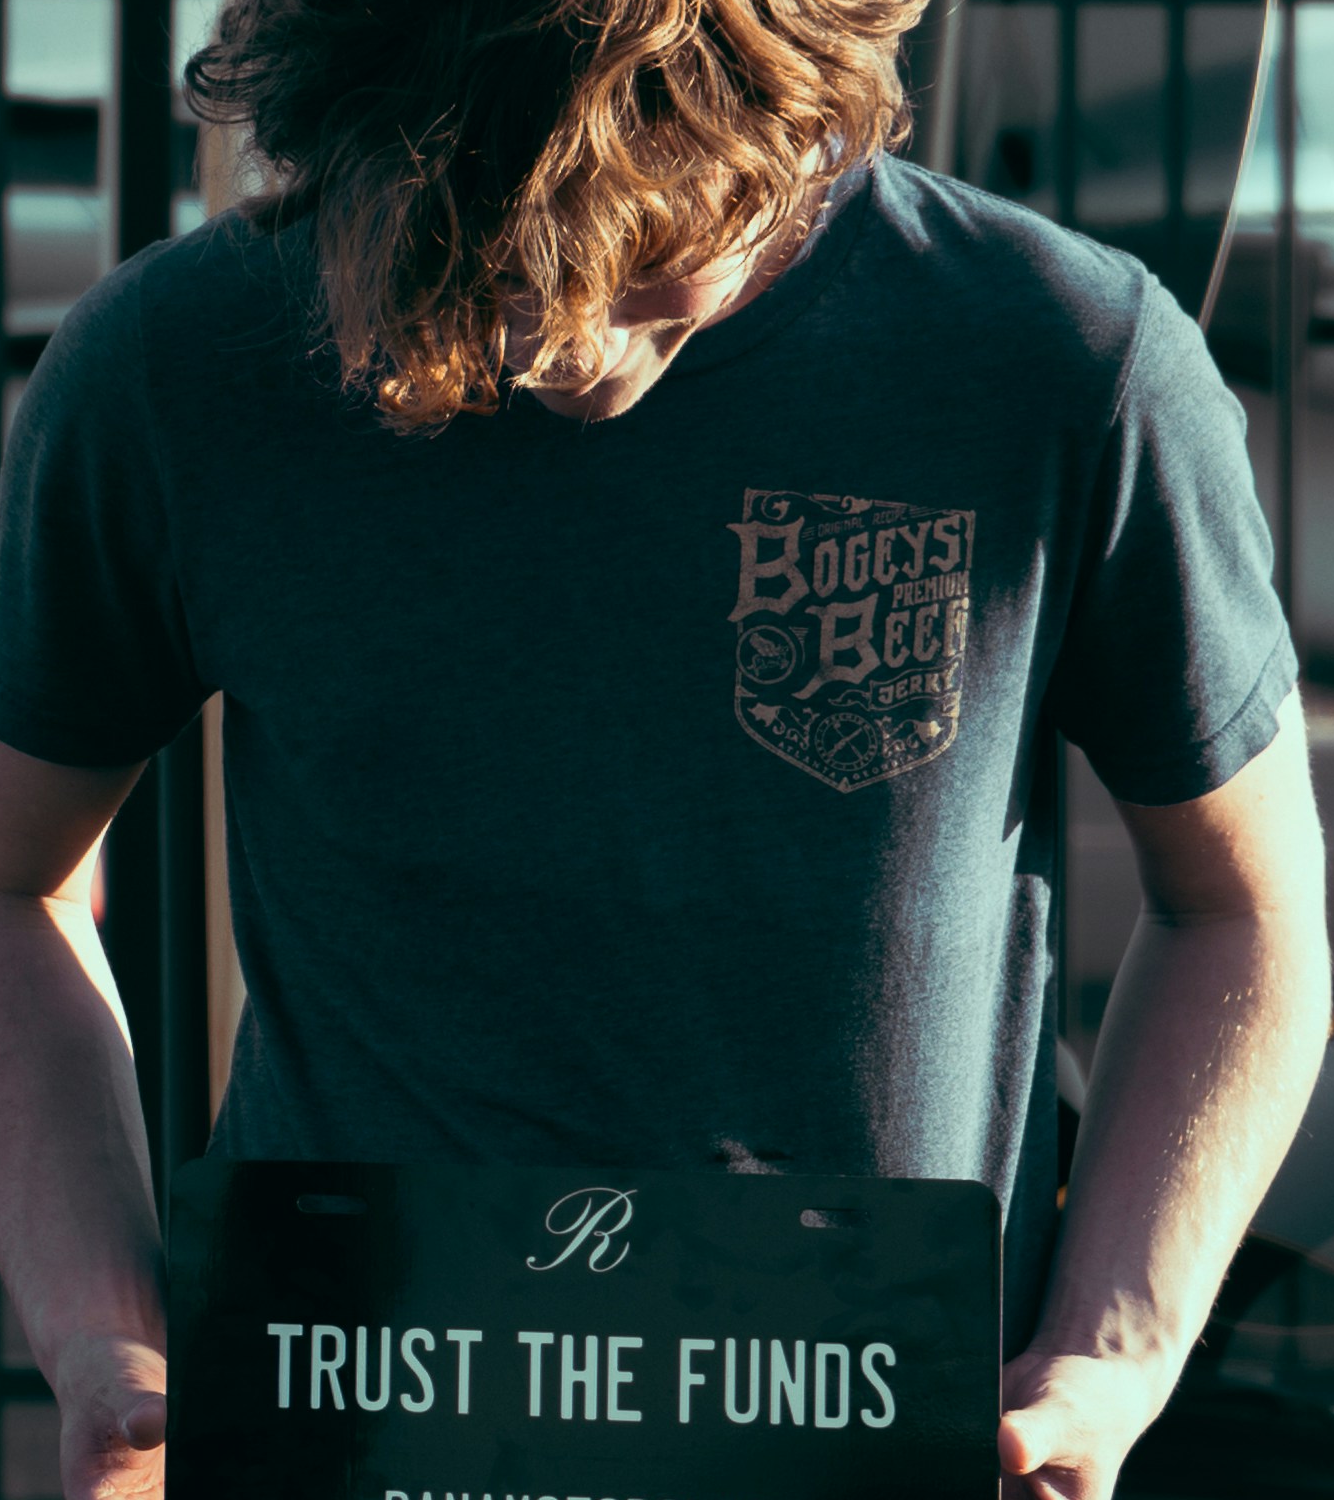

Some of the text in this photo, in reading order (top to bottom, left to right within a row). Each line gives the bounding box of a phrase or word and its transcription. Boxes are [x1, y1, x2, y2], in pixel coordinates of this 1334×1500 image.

[817, 507, 908, 538] ORIGINAL RECIPE
[726, 513, 962, 623] BOGEYS
[892, 570, 970, 609] PREMIUM
[791, 592, 971, 700] BEEF
[877, 661, 960, 704] JERKY
[268, 1324, 896, 1428] TRUST THE FUNDS
